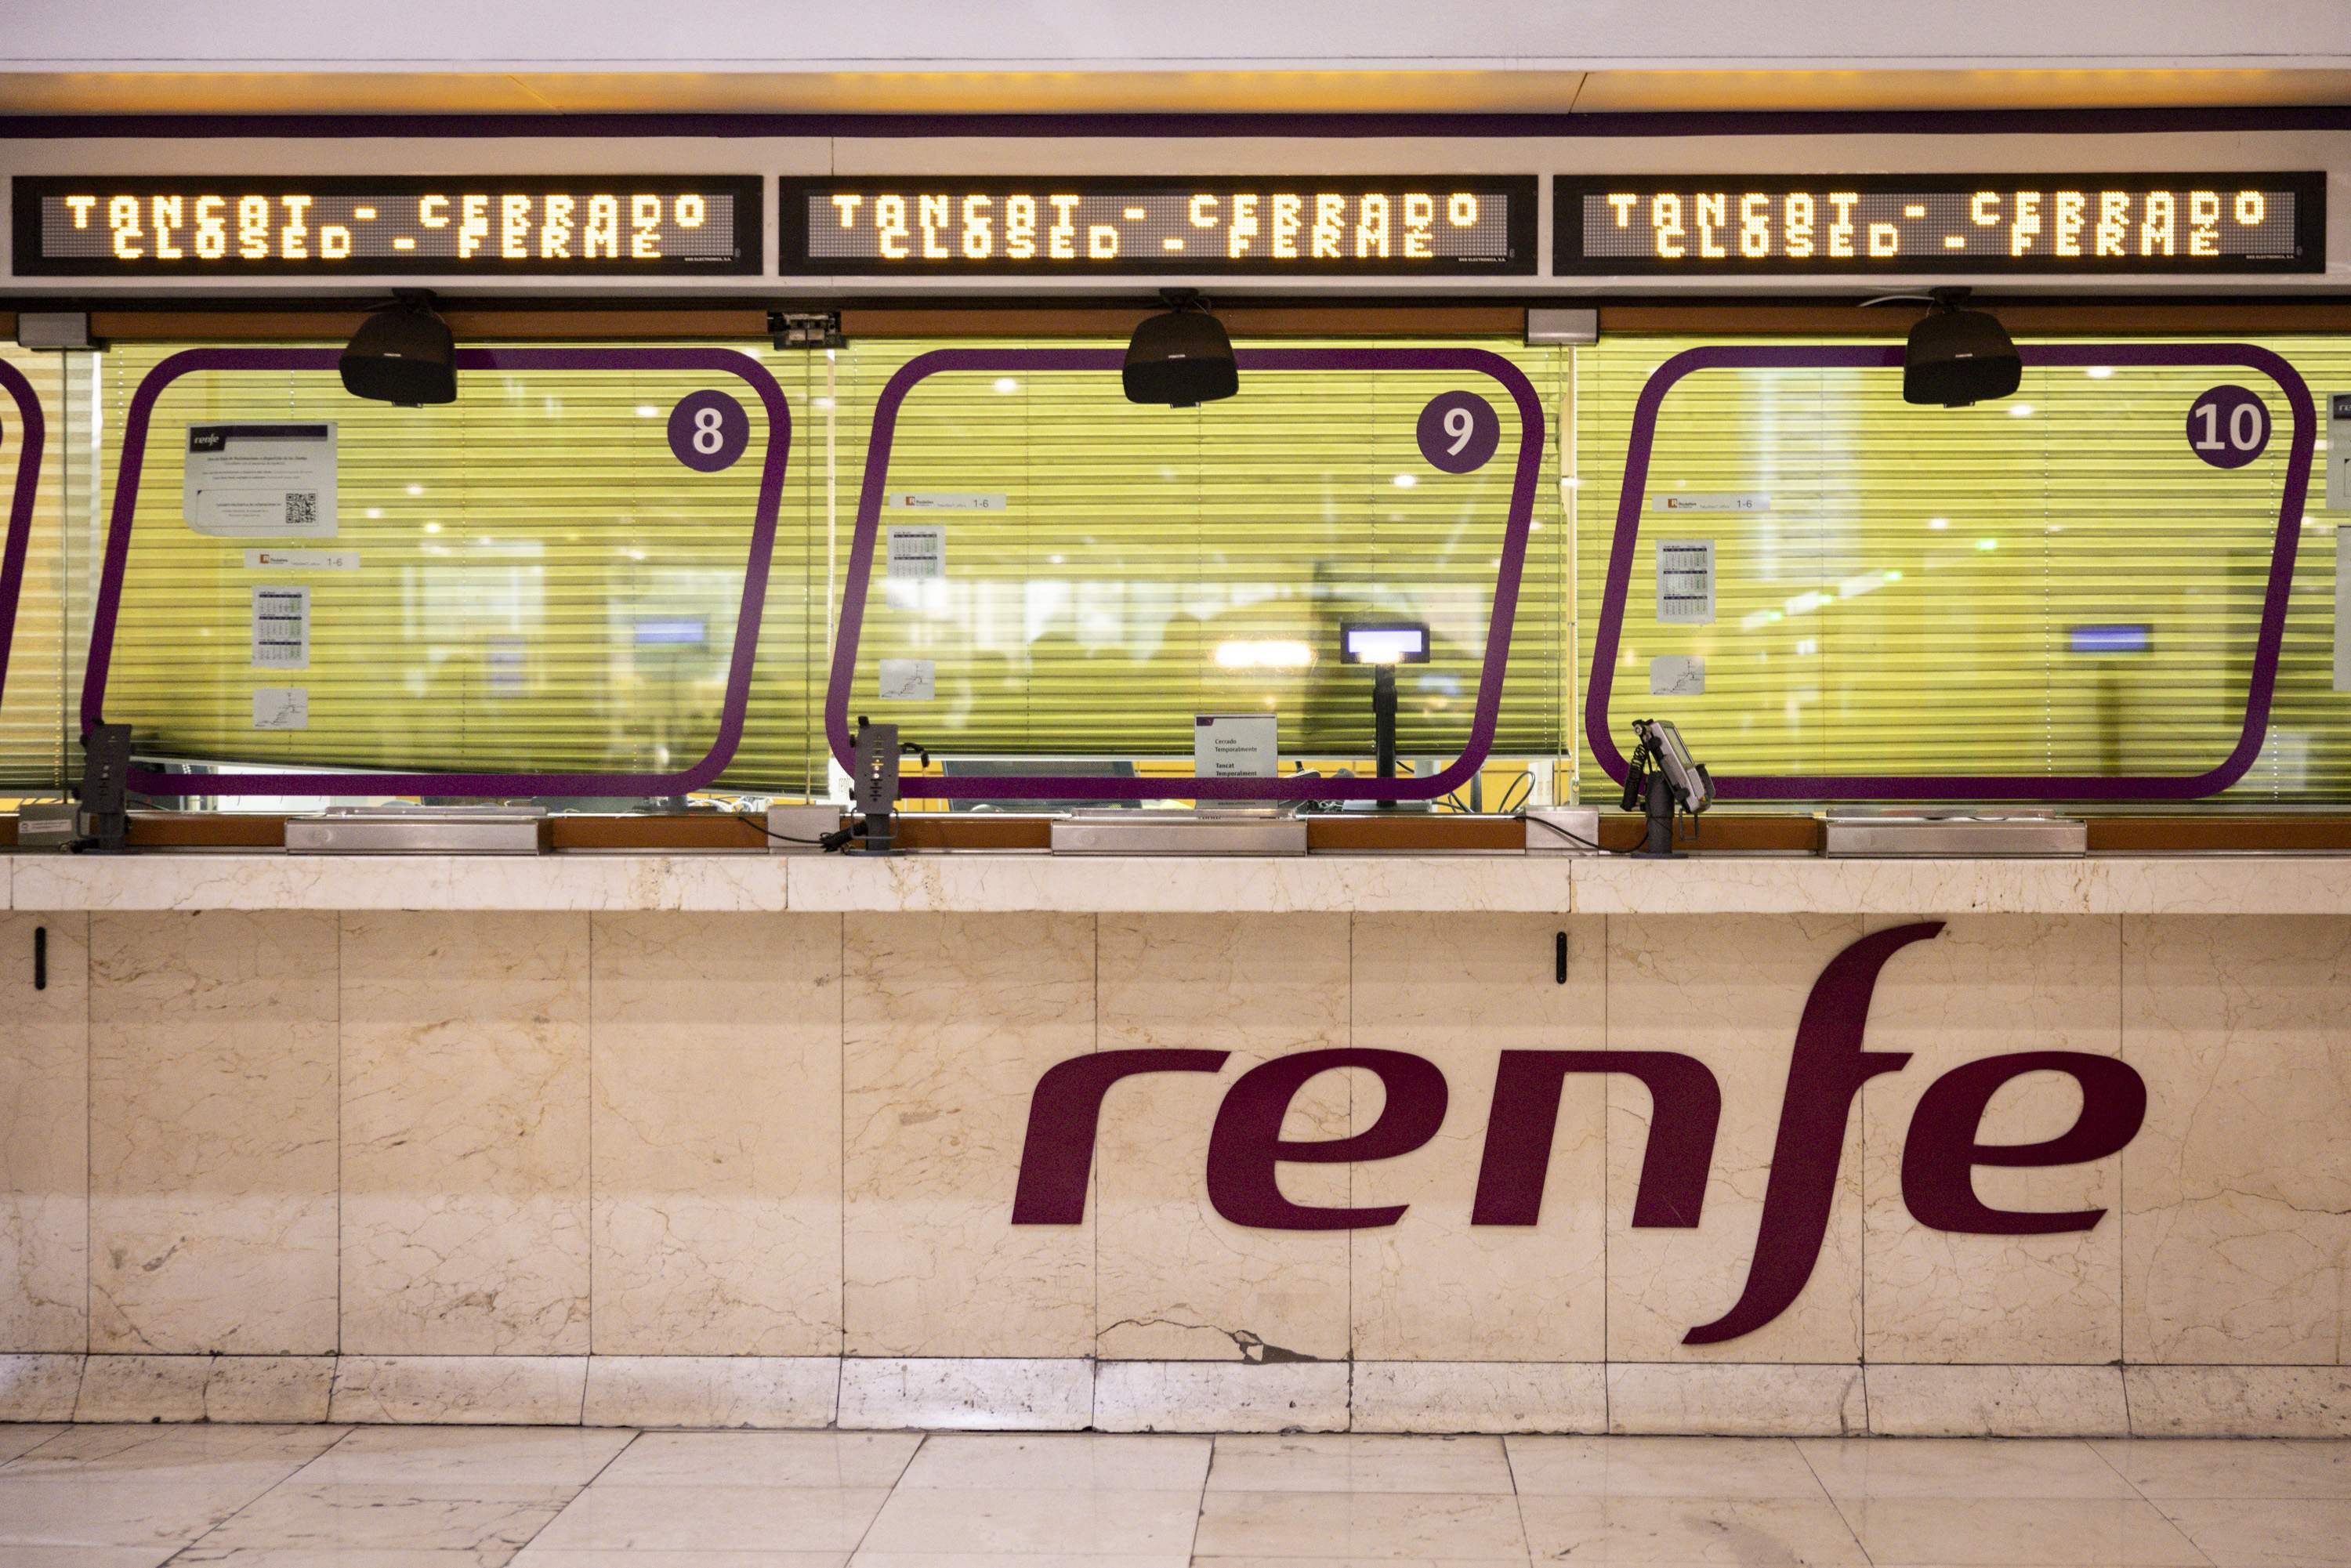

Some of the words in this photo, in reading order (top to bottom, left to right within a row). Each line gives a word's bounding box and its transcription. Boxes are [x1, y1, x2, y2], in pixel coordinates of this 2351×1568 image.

[65, 194, 312, 228] TANCAT
[418, 194, 705, 227] CERRADO
[831, 194, 1080, 227] TANCAT
[1188, 193, 1478, 226] CERRADO
[1607, 192, 1858, 226] TANCAT
[1970, 190, 2265, 225] CERRADO
[113, 225, 352, 259] CLOSED
[878, 225, 1119, 259] CLOSED
[1655, 223, 1899, 257] CLOSED
[194, 433, 219, 446] renfe
[693, 407, 723, 454] 8
[1444, 407, 1474, 456] 9
[2195, 403, 2262, 451] 10
[973, 498, 989, 508] 1-6
[1737, 499, 1752, 509] 1-6
[1011, 921, 2147, 1345] renfe
